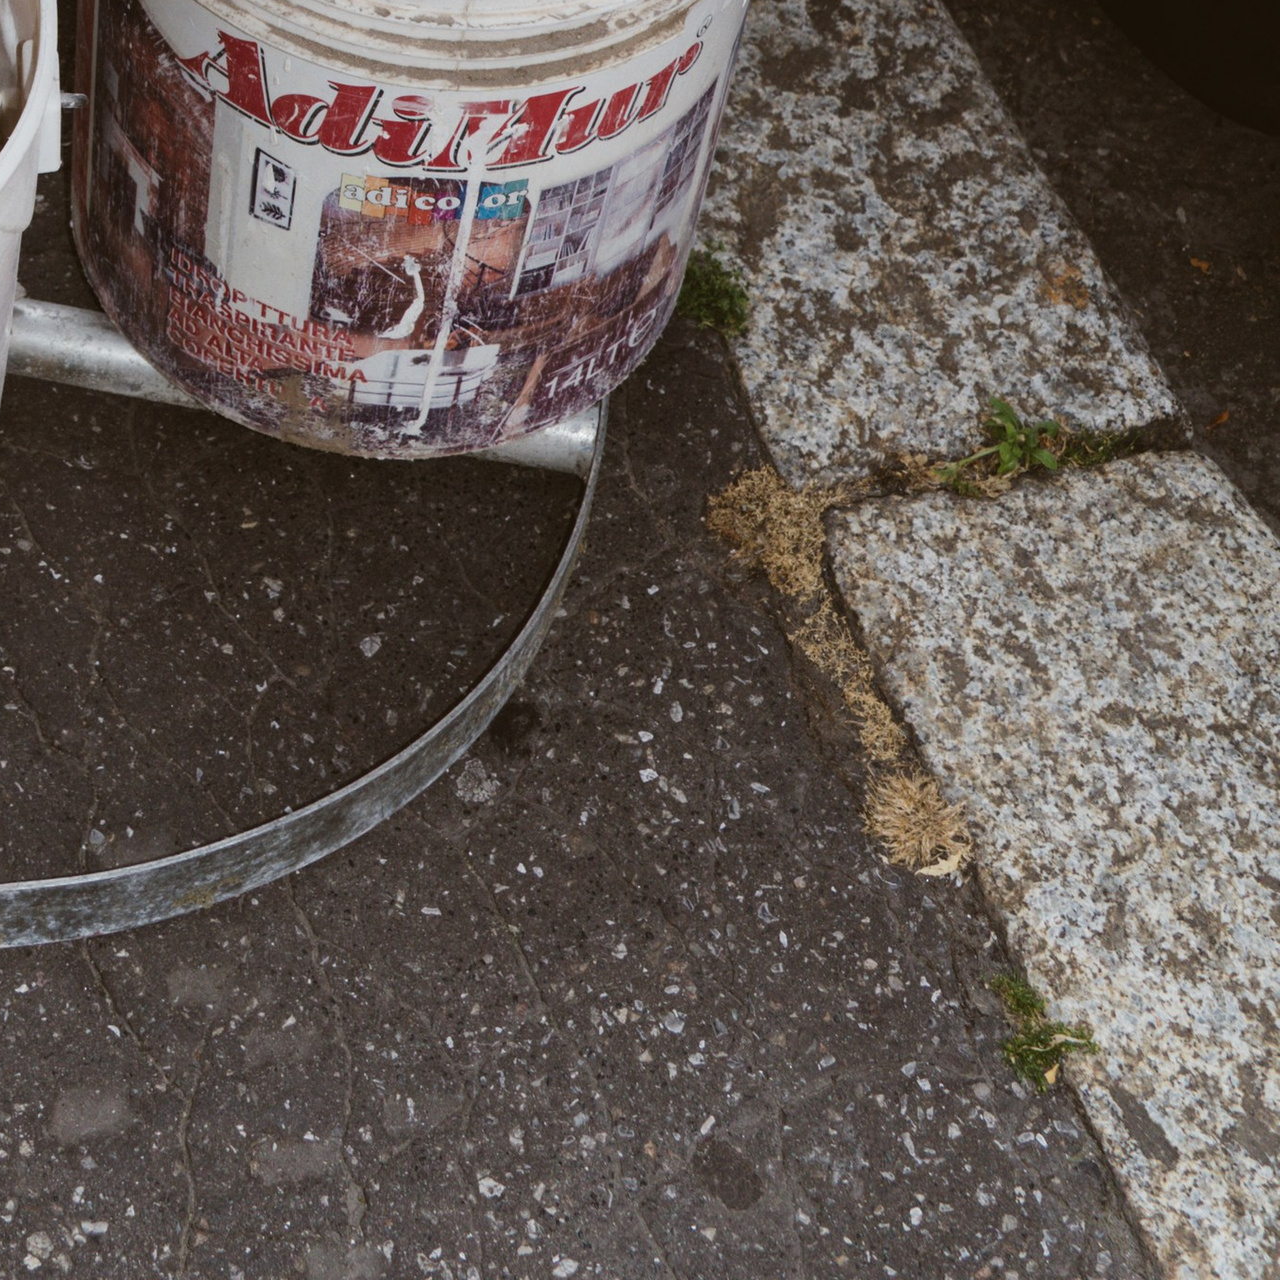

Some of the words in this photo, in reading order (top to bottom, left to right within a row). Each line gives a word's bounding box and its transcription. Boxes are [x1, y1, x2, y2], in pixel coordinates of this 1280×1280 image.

[343, 183, 528, 210] adicoor
[167, 306, 201, 338] AD
[168, 286, 368, 384] BIANCHISSIMA
[170, 246, 353, 347] IDROPTTURA
[166, 324, 328, 413] COPERTUA
